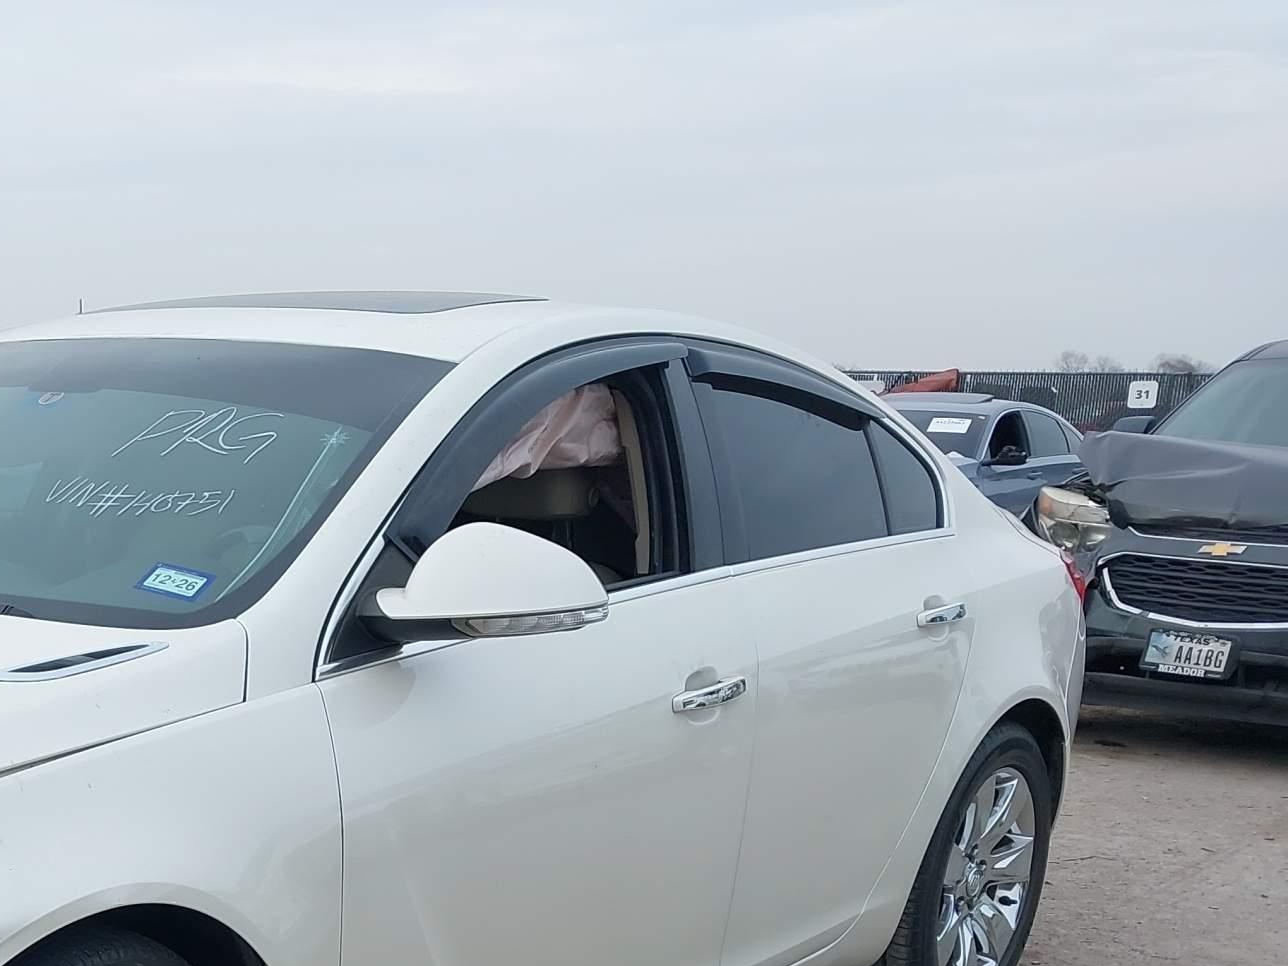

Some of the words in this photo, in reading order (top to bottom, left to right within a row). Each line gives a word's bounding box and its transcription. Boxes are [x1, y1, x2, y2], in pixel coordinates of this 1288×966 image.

[1135, 389, 1150, 400] 31
[111, 406, 285, 464] PRG
[1174, 635, 1211, 646] TEXAS
[1174, 645, 1225, 669] AA1BG
[1157, 664, 1206, 678] MEADOR
